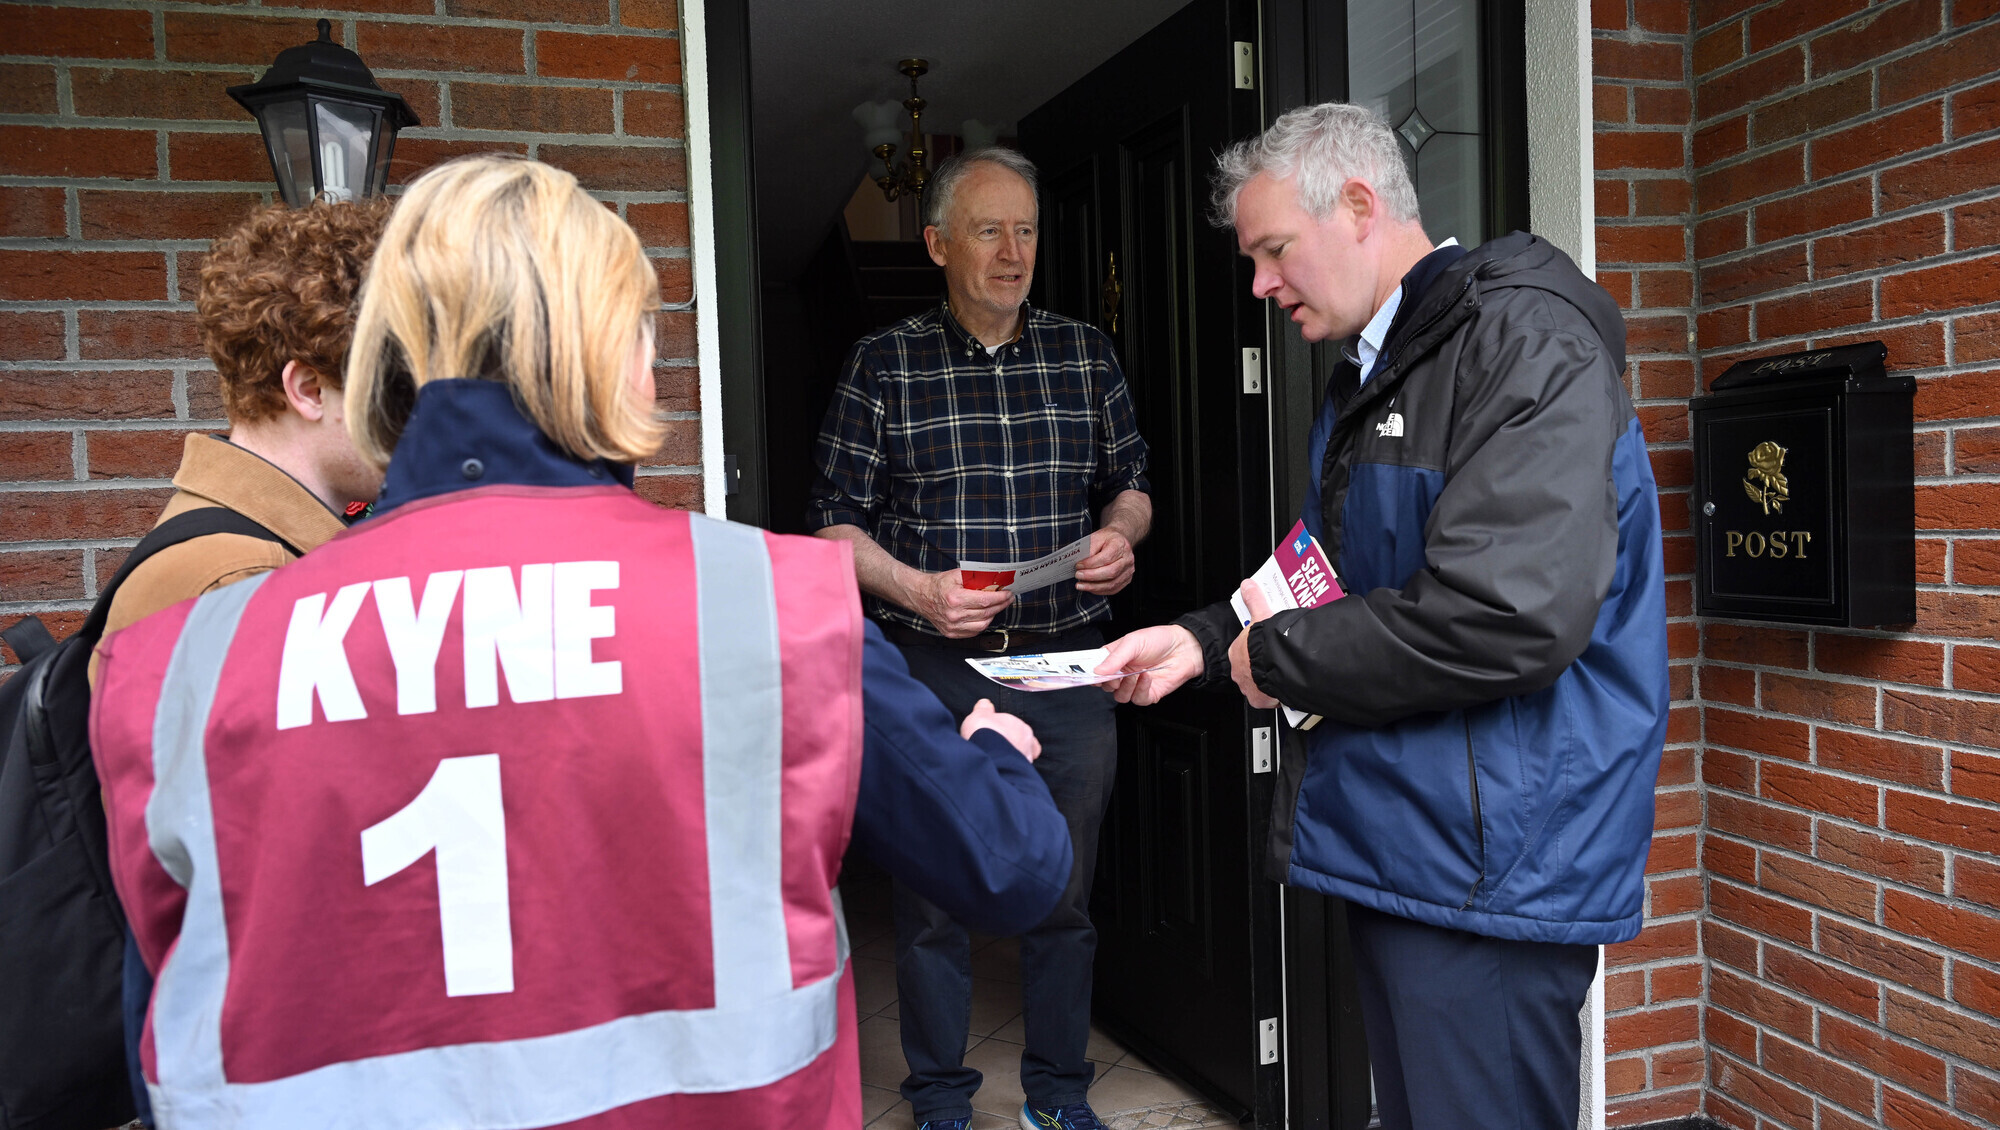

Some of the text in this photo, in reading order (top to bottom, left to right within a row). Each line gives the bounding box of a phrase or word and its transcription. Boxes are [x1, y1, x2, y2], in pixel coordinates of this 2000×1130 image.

[1751, 352, 1832, 374] POST
[1725, 531, 1811, 558] POST
[1301, 556, 1330, 599] SEÁN
[276, 560, 623, 731] KYNE
[360, 753, 514, 997] 1
